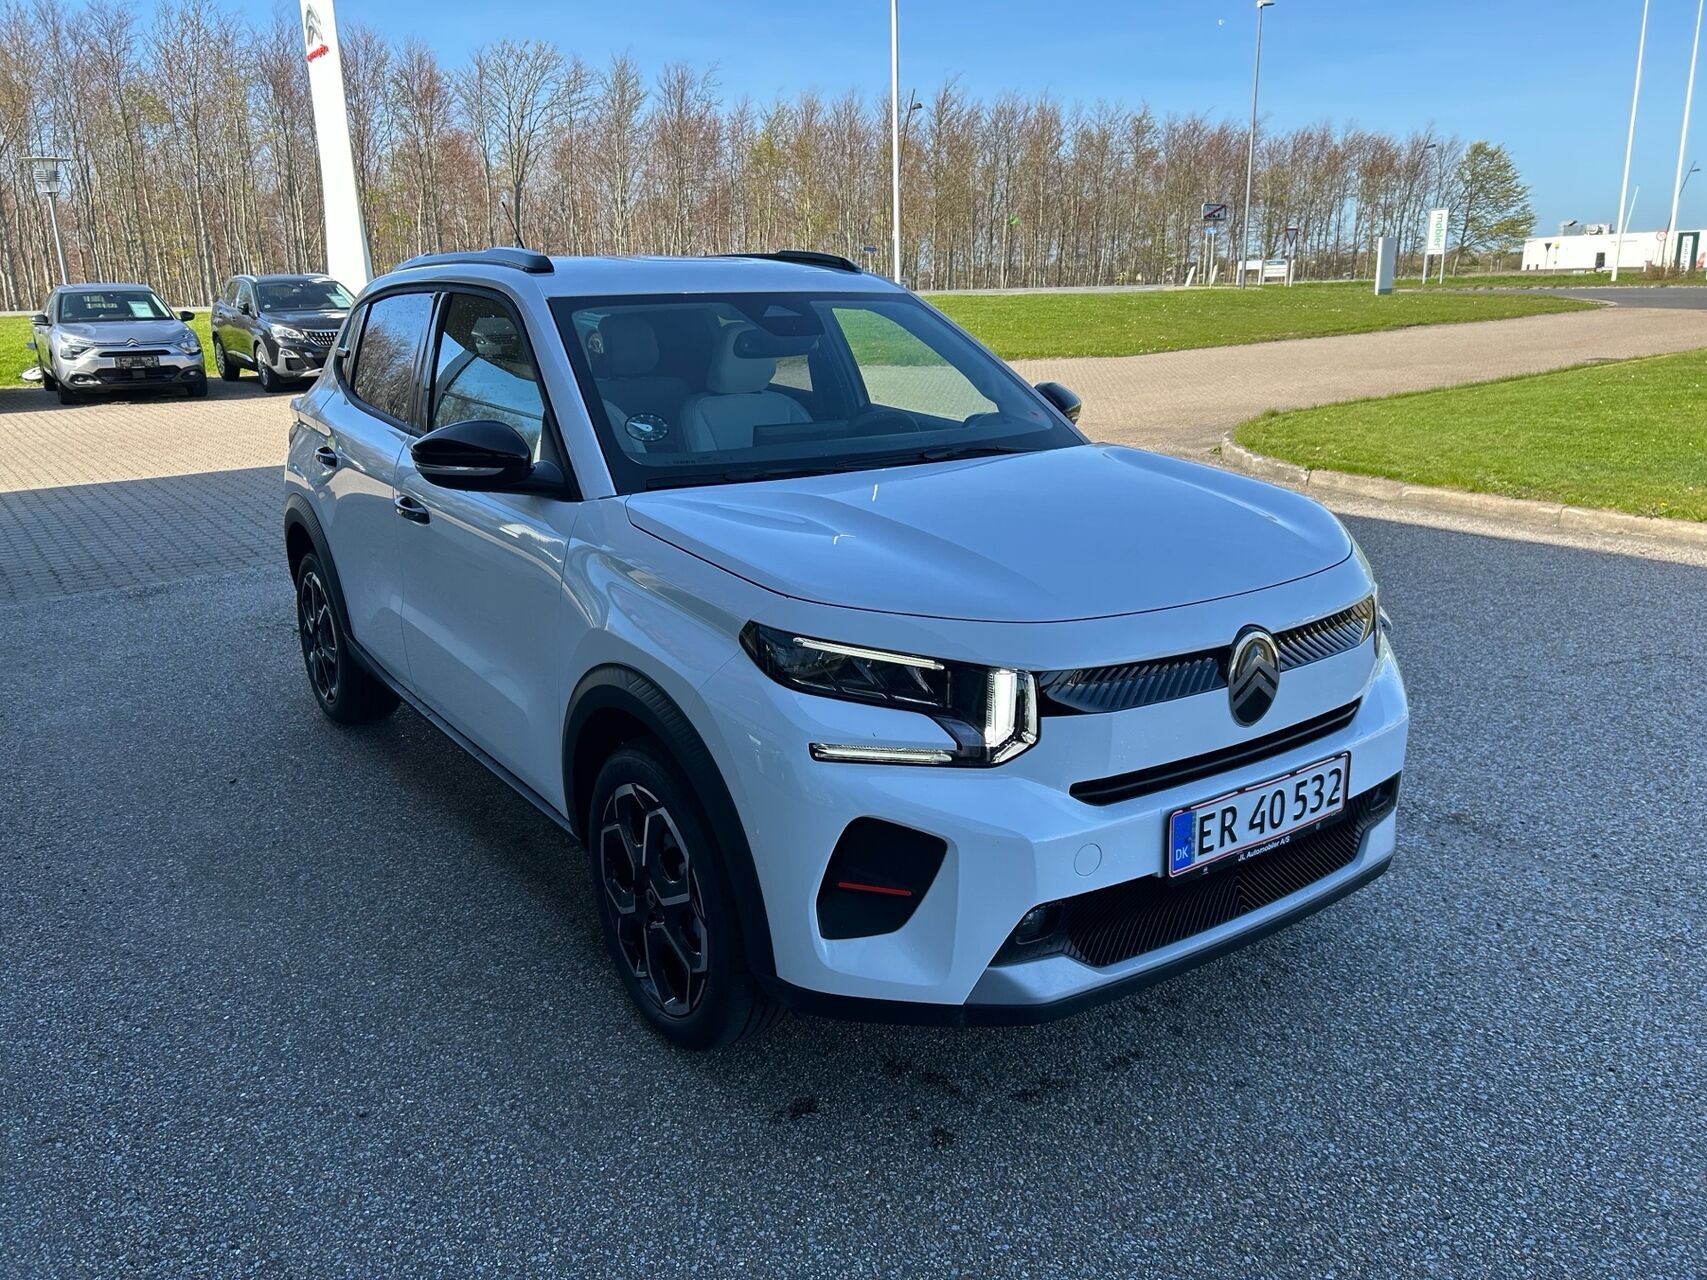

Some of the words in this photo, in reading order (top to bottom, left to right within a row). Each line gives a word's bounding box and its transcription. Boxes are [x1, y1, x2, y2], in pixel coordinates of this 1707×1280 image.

[1198, 806, 1238, 857] ER
[1248, 789, 1286, 835] 40
[1293, 768, 1342, 821] 532
[1175, 845, 1188, 862] DK
[1246, 842, 1280, 858] Automobiler
[1279, 835, 1291, 846] A/S
